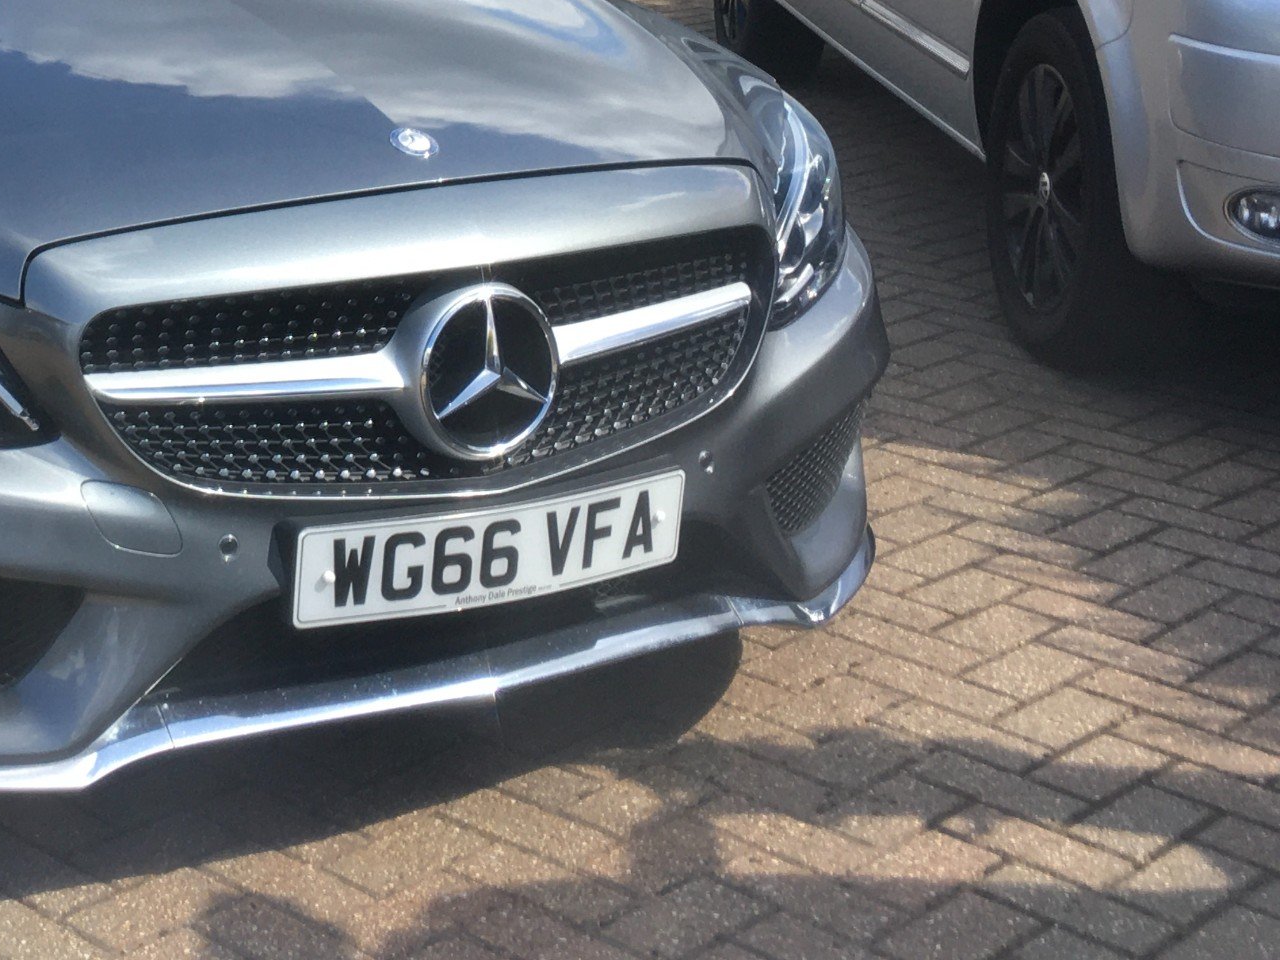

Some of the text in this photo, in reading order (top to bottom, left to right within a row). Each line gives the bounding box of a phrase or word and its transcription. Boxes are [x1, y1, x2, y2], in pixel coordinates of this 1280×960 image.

[333, 490, 654, 608] WG66 VFA
[455, 594, 486, 605] Anthony
[488, 590, 505, 600] Dale
[507, 584, 537, 597] Prestige
